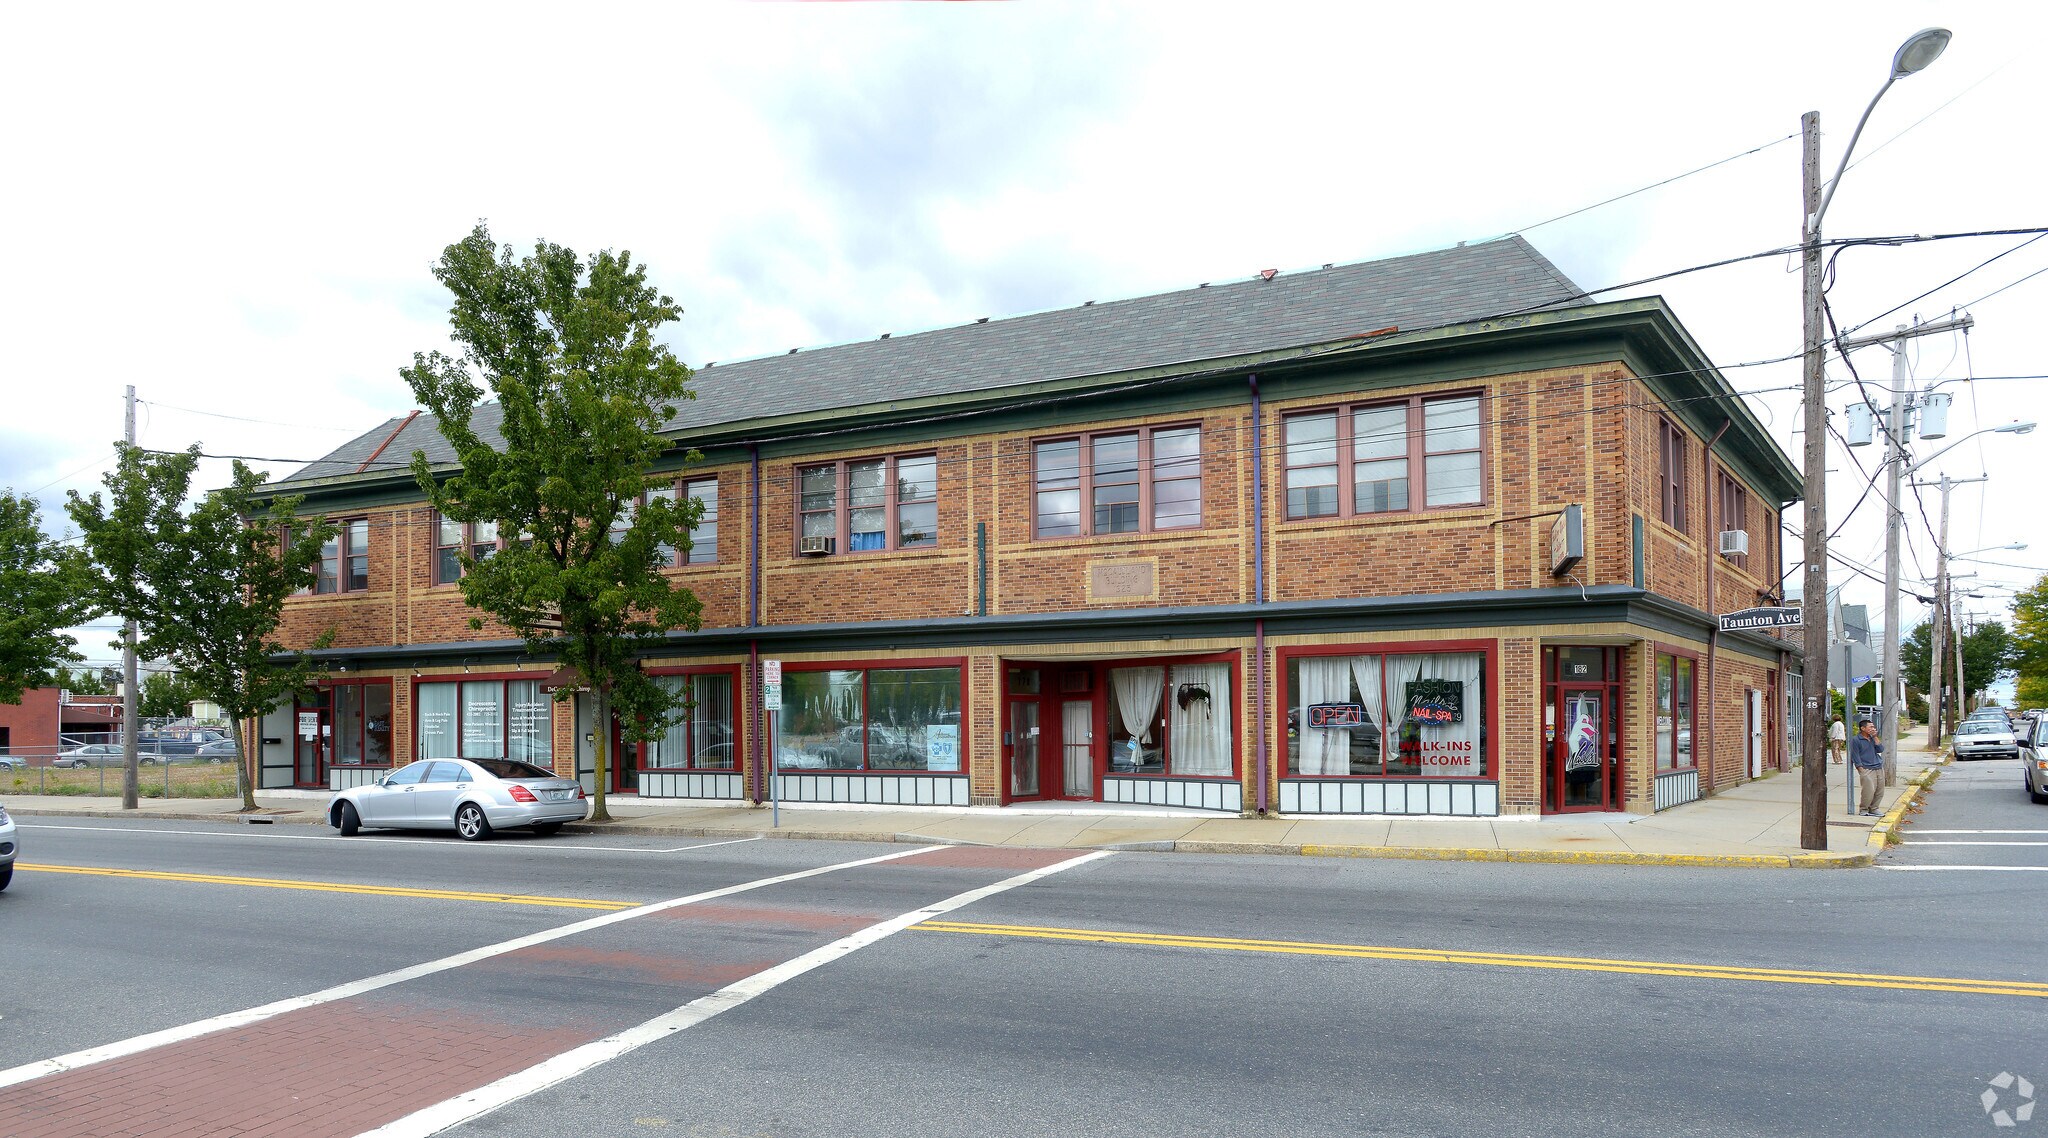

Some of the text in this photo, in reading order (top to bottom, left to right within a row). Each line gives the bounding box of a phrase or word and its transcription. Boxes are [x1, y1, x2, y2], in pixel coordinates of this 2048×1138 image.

[1105, 575, 1139, 584] BUILDING
[1722, 613, 1800, 628] Taunton Ave
[1575, 665, 1587, 673] 182
[1409, 682, 1460, 693] FASHION
[1311, 707, 1360, 725] OPEN
[1412, 707, 1452, 721] NAIL-SPA
[1401, 741, 1472, 751] WALK-INS
[1402, 755, 1471, 766] WELCOME
